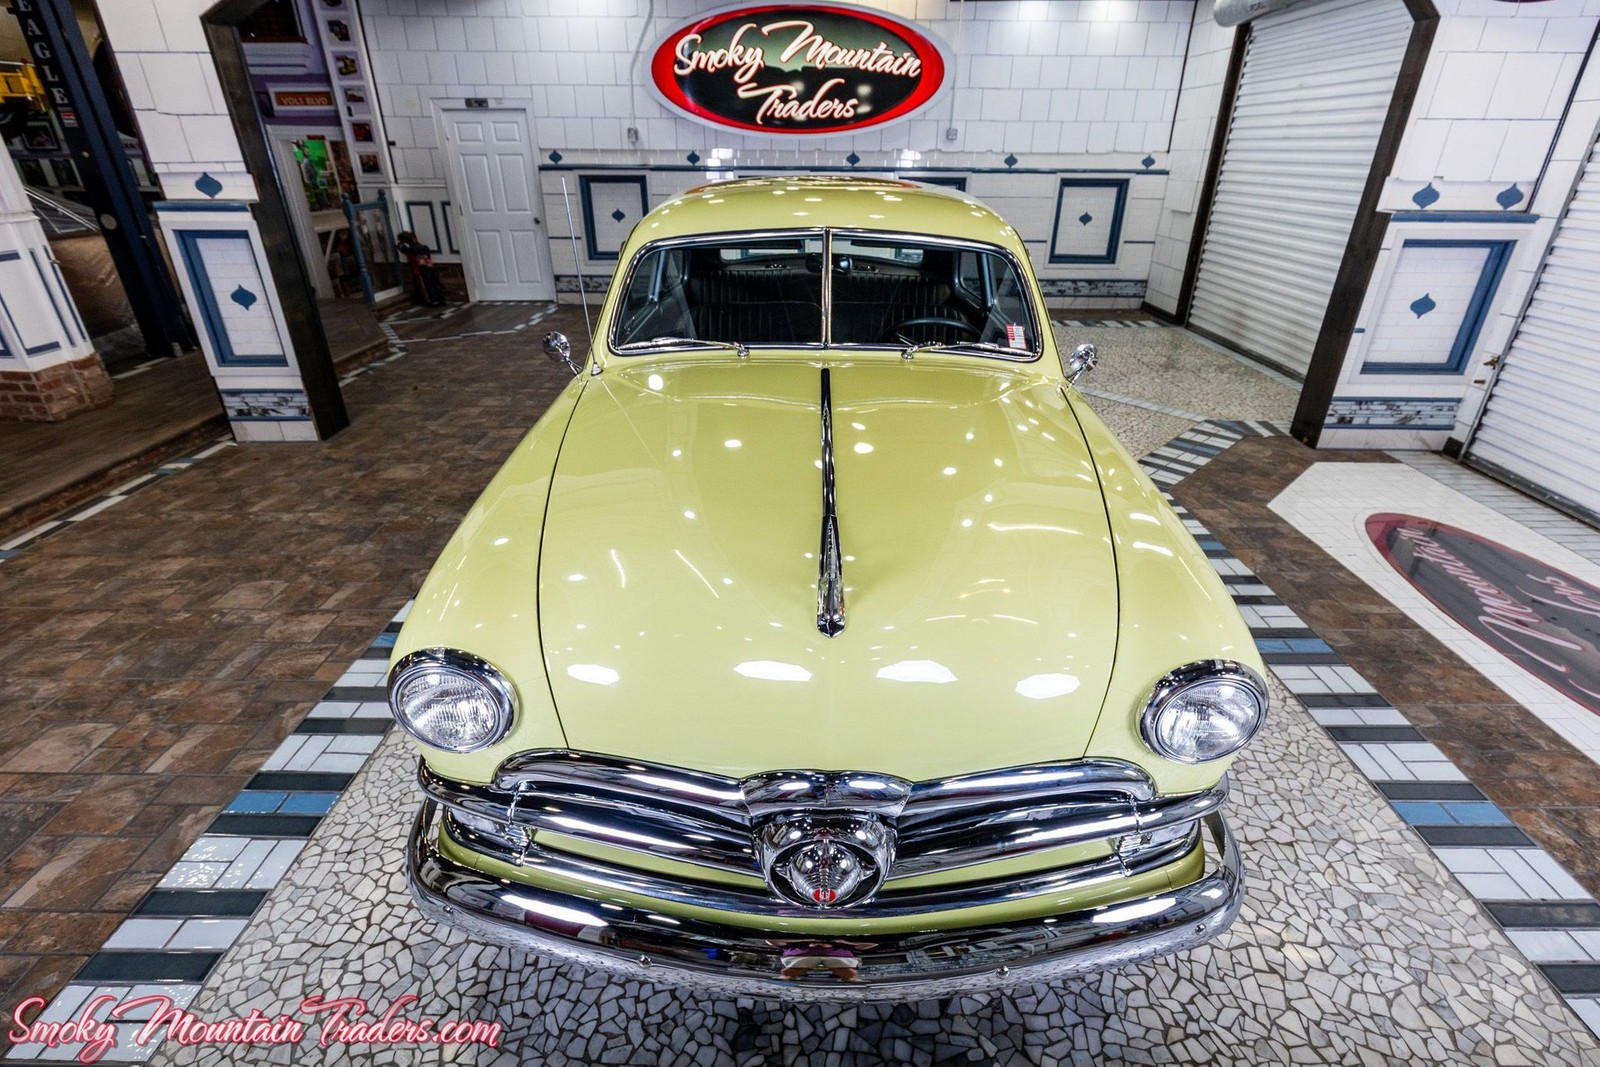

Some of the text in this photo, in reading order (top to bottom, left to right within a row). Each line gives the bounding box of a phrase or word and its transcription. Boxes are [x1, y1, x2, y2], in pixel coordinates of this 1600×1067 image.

[18, 0, 69, 104] EAGLE
[674, 21, 922, 83] Smoky Mountain
[737, 78, 859, 124] Traders
